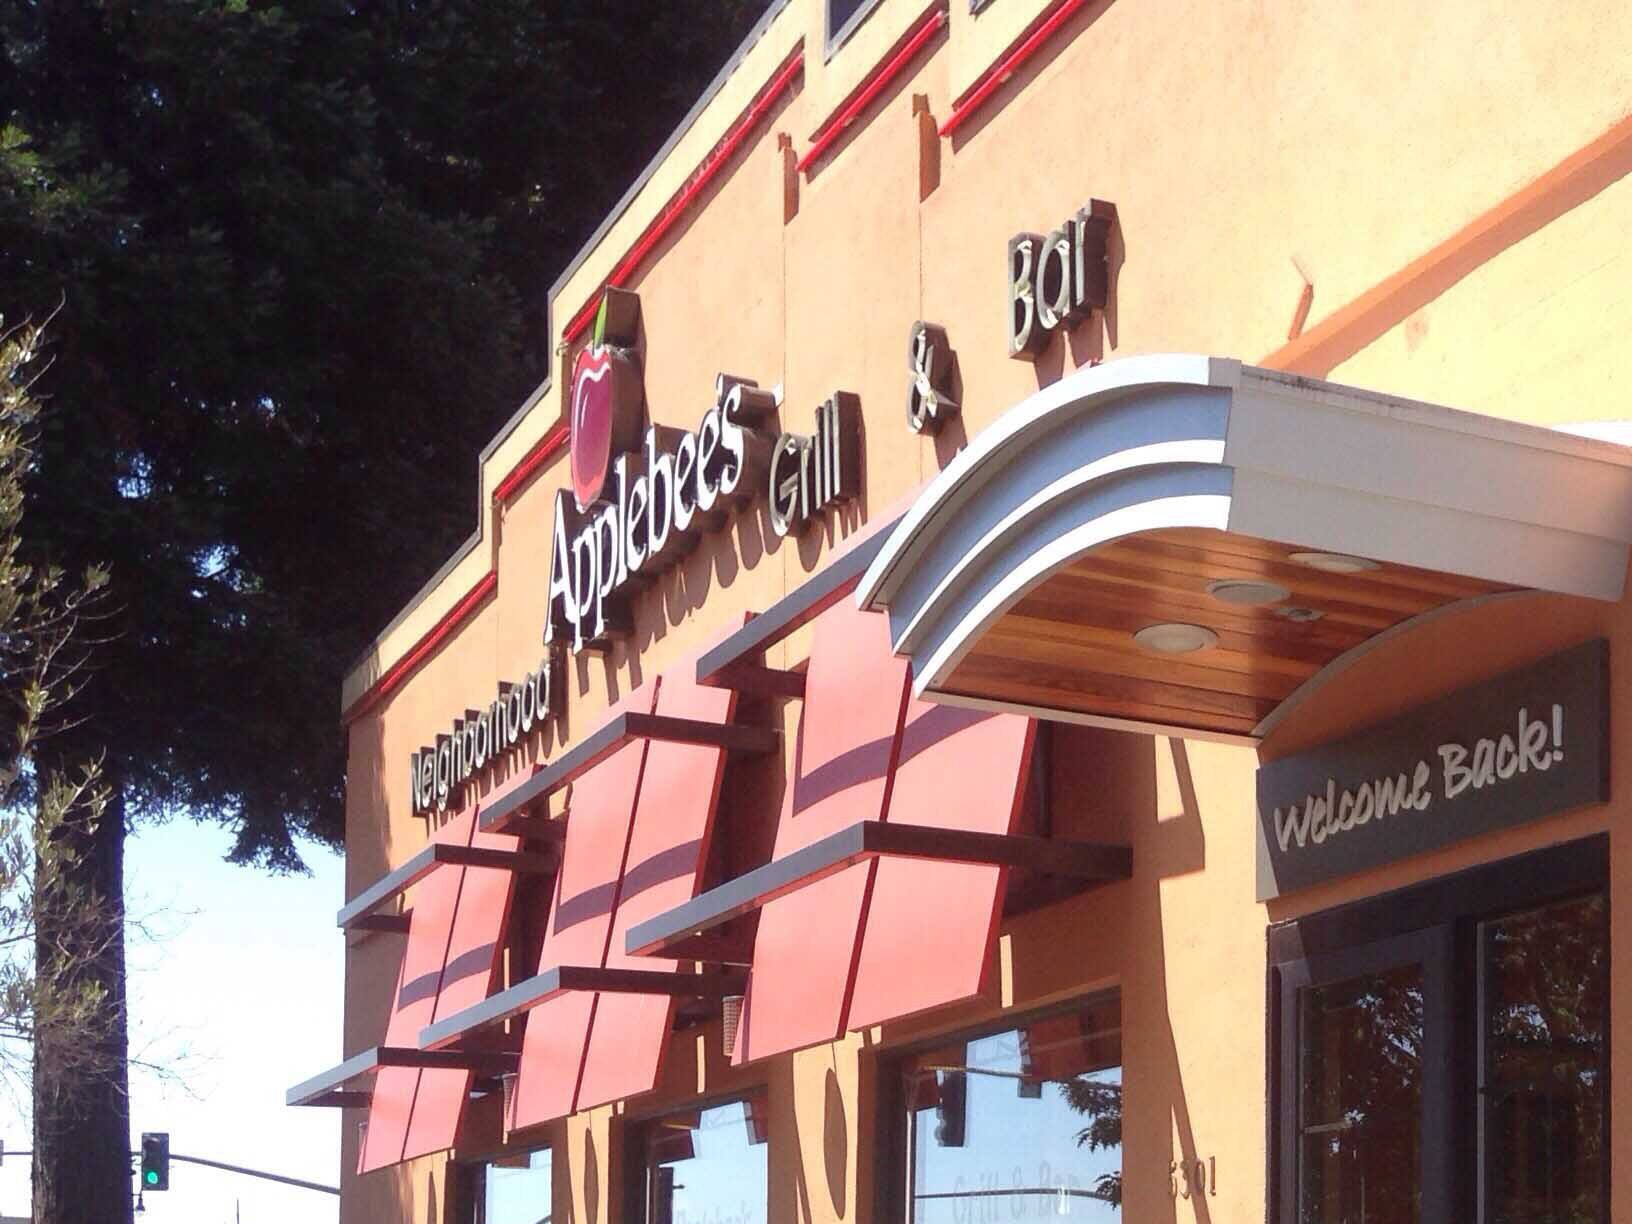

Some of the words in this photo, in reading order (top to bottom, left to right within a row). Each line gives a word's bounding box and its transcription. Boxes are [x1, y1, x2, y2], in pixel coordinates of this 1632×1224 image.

[543, 372, 750, 655] Applebee's
[769, 390, 850, 537] Grill
[907, 320, 945, 434] &
[1008, 198, 1101, 358] Bar
[1273, 760, 1432, 852] Welcome
[1437, 704, 1564, 799] Back!
